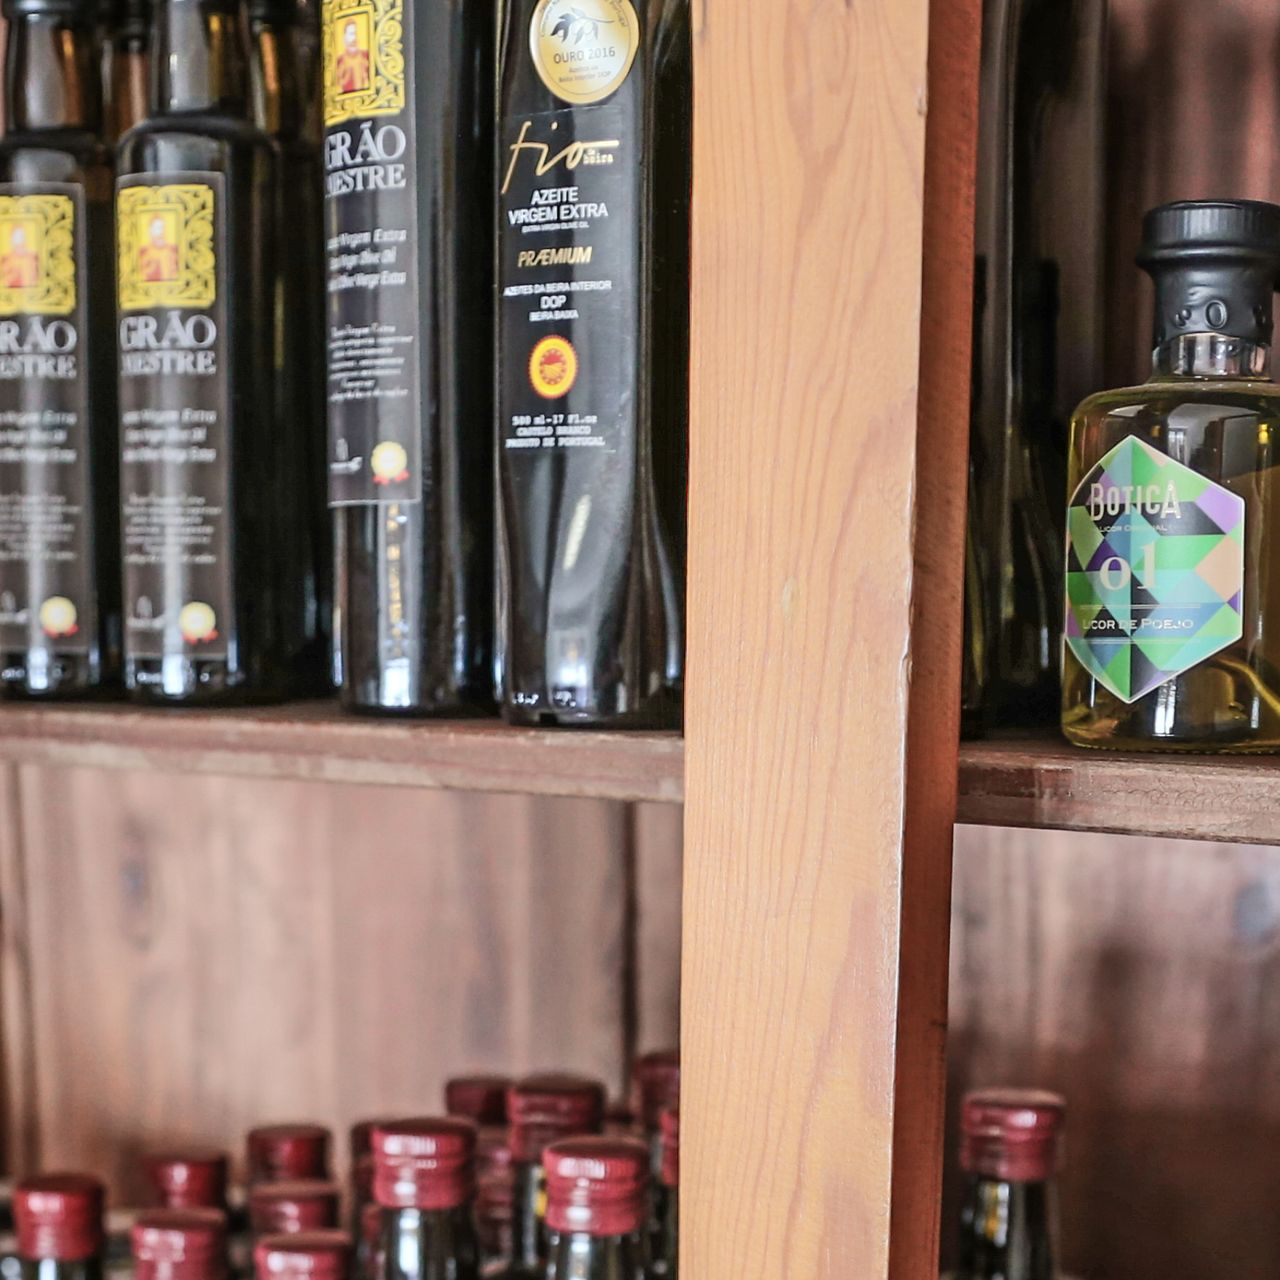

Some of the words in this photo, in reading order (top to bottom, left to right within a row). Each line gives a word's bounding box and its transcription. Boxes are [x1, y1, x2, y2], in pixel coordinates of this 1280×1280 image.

[553, 50, 585, 64] OURO
[588, 46, 616, 60] 2016
[324, 119, 407, 171] GRÃO
[530, 186, 579, 205] AZEITE
[508, 205, 558, 225] VIRGEM
[560, 202, 609, 221] EXTRA
[517, 246, 593, 268] PRÆMIUM
[570, 280, 612, 292] INTERIOR
[540, 295, 567, 310] DOP
[120, 309, 218, 350] GRÃO
[1090, 479, 1182, 522] BOTICA
